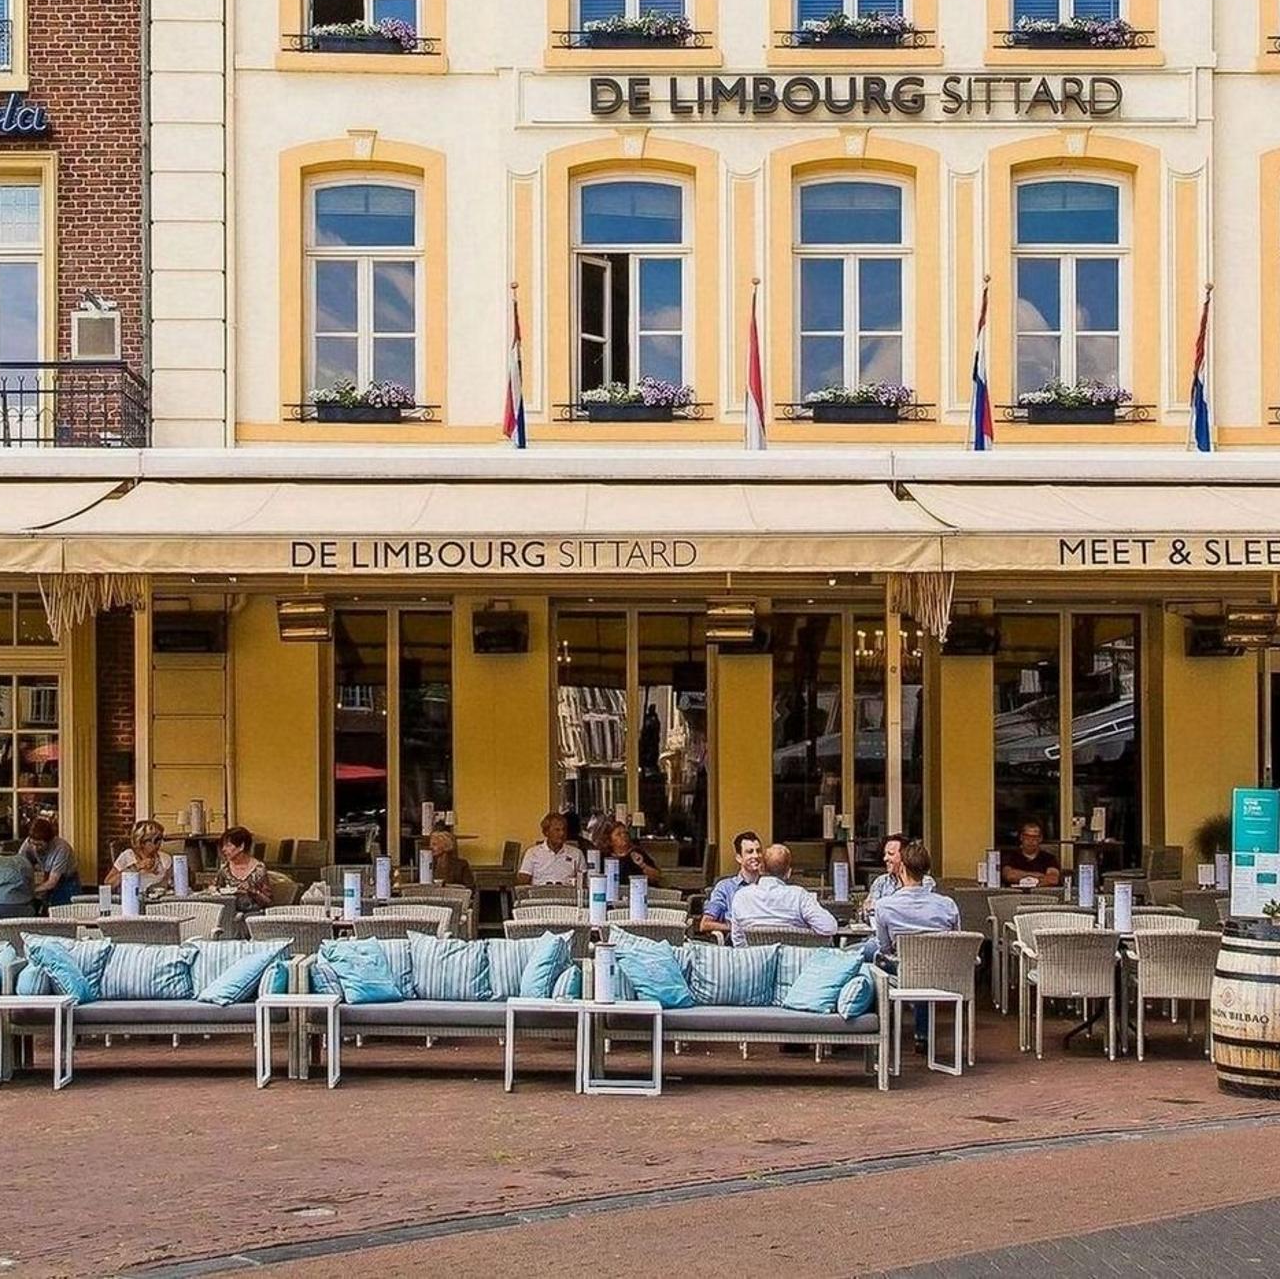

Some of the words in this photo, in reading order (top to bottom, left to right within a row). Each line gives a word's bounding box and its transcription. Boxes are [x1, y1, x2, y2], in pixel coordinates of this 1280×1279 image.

[590, 77, 652, 115] DE
[670, 77, 927, 115] LIMBOURG
[941, 76, 1123, 115] SITTARD
[291, 541, 337, 568] DE
[352, 541, 546, 568] LIMBOURG
[559, 540, 698, 568] SITTARD
[1058, 539, 1156, 565] MEET
[1169, 539, 1192, 565] &
